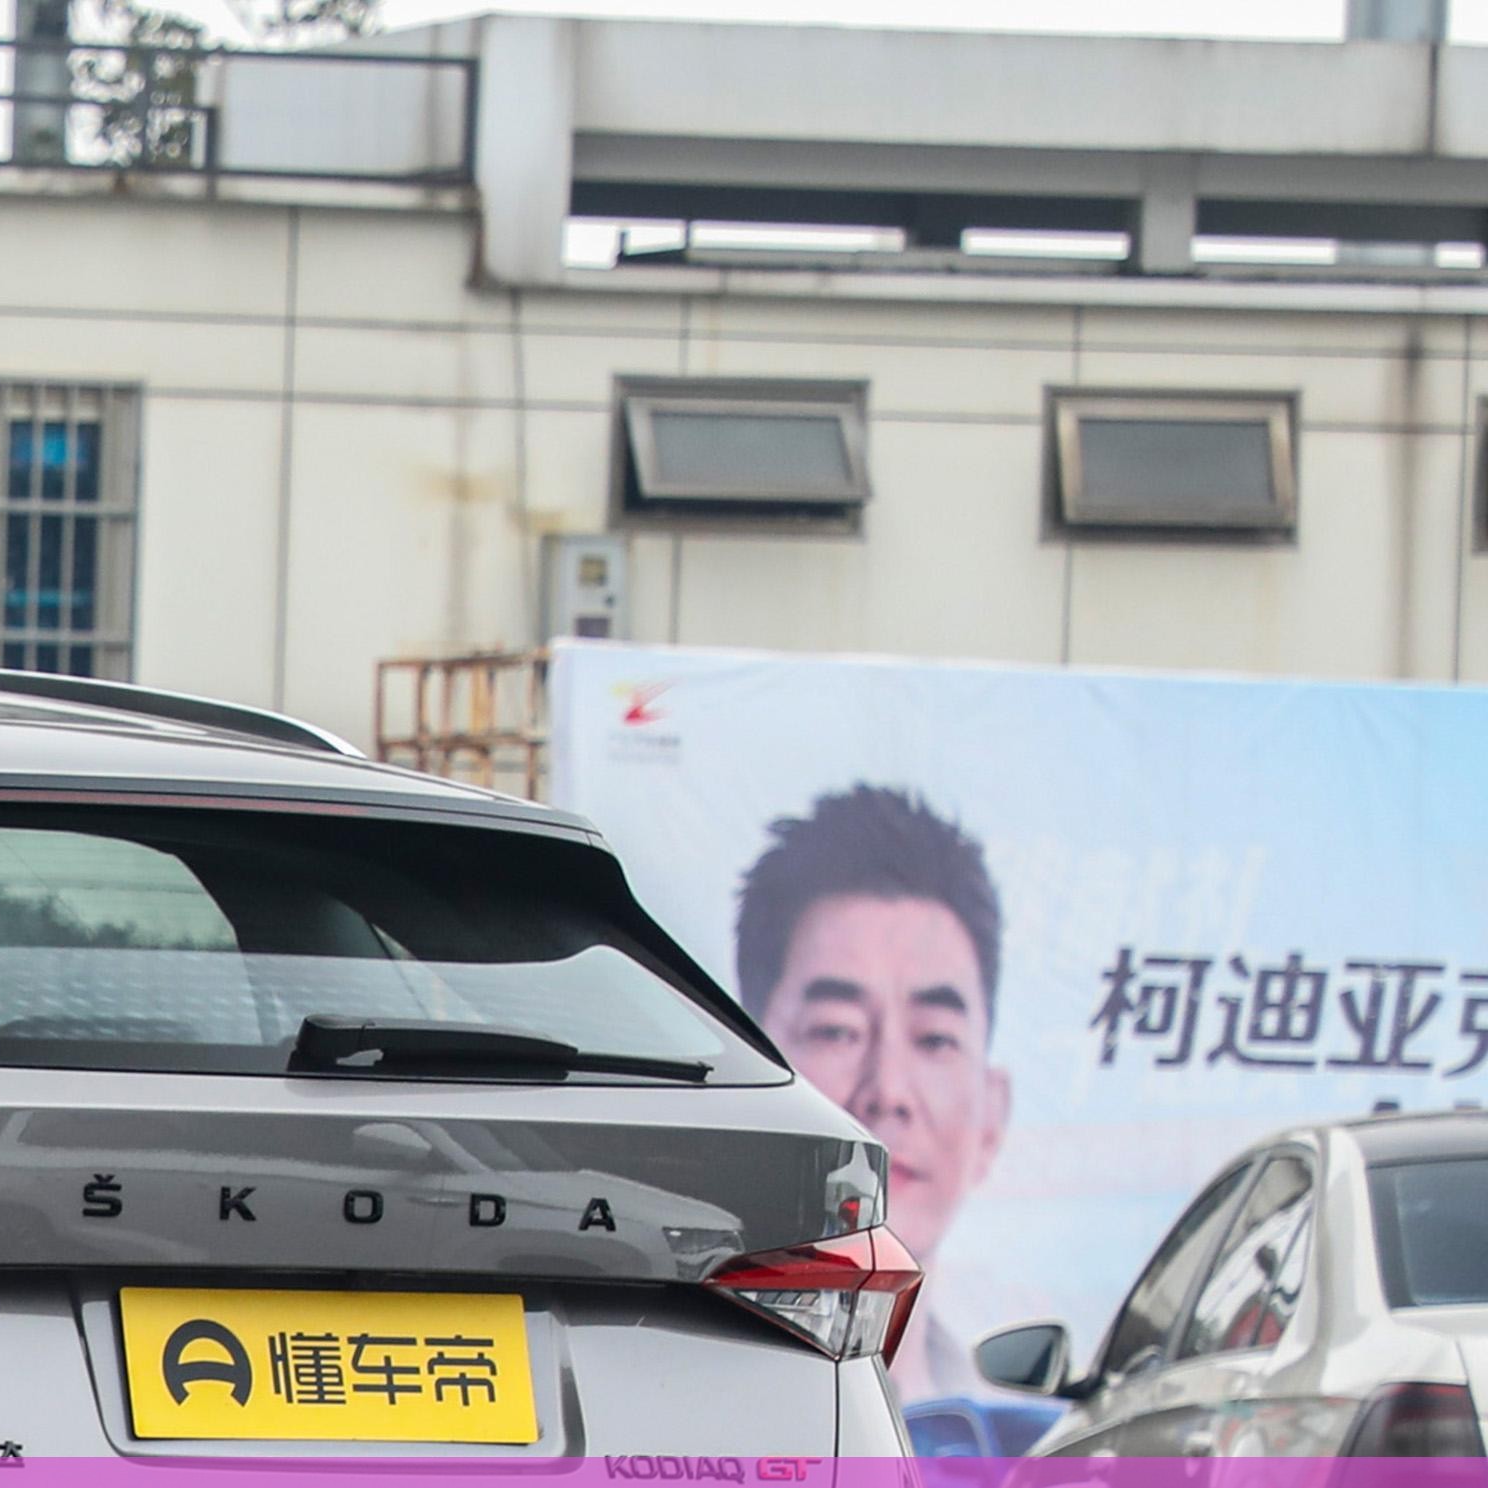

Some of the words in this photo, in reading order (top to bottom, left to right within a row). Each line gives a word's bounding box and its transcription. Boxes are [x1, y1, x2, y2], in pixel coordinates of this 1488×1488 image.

[81, 1173, 617, 1232] ŠKODA
[267, 1331, 499, 1407] 懂车帝
[603, 1454, 747, 1485] KODIAQ
[755, 1455, 823, 1483] GT
